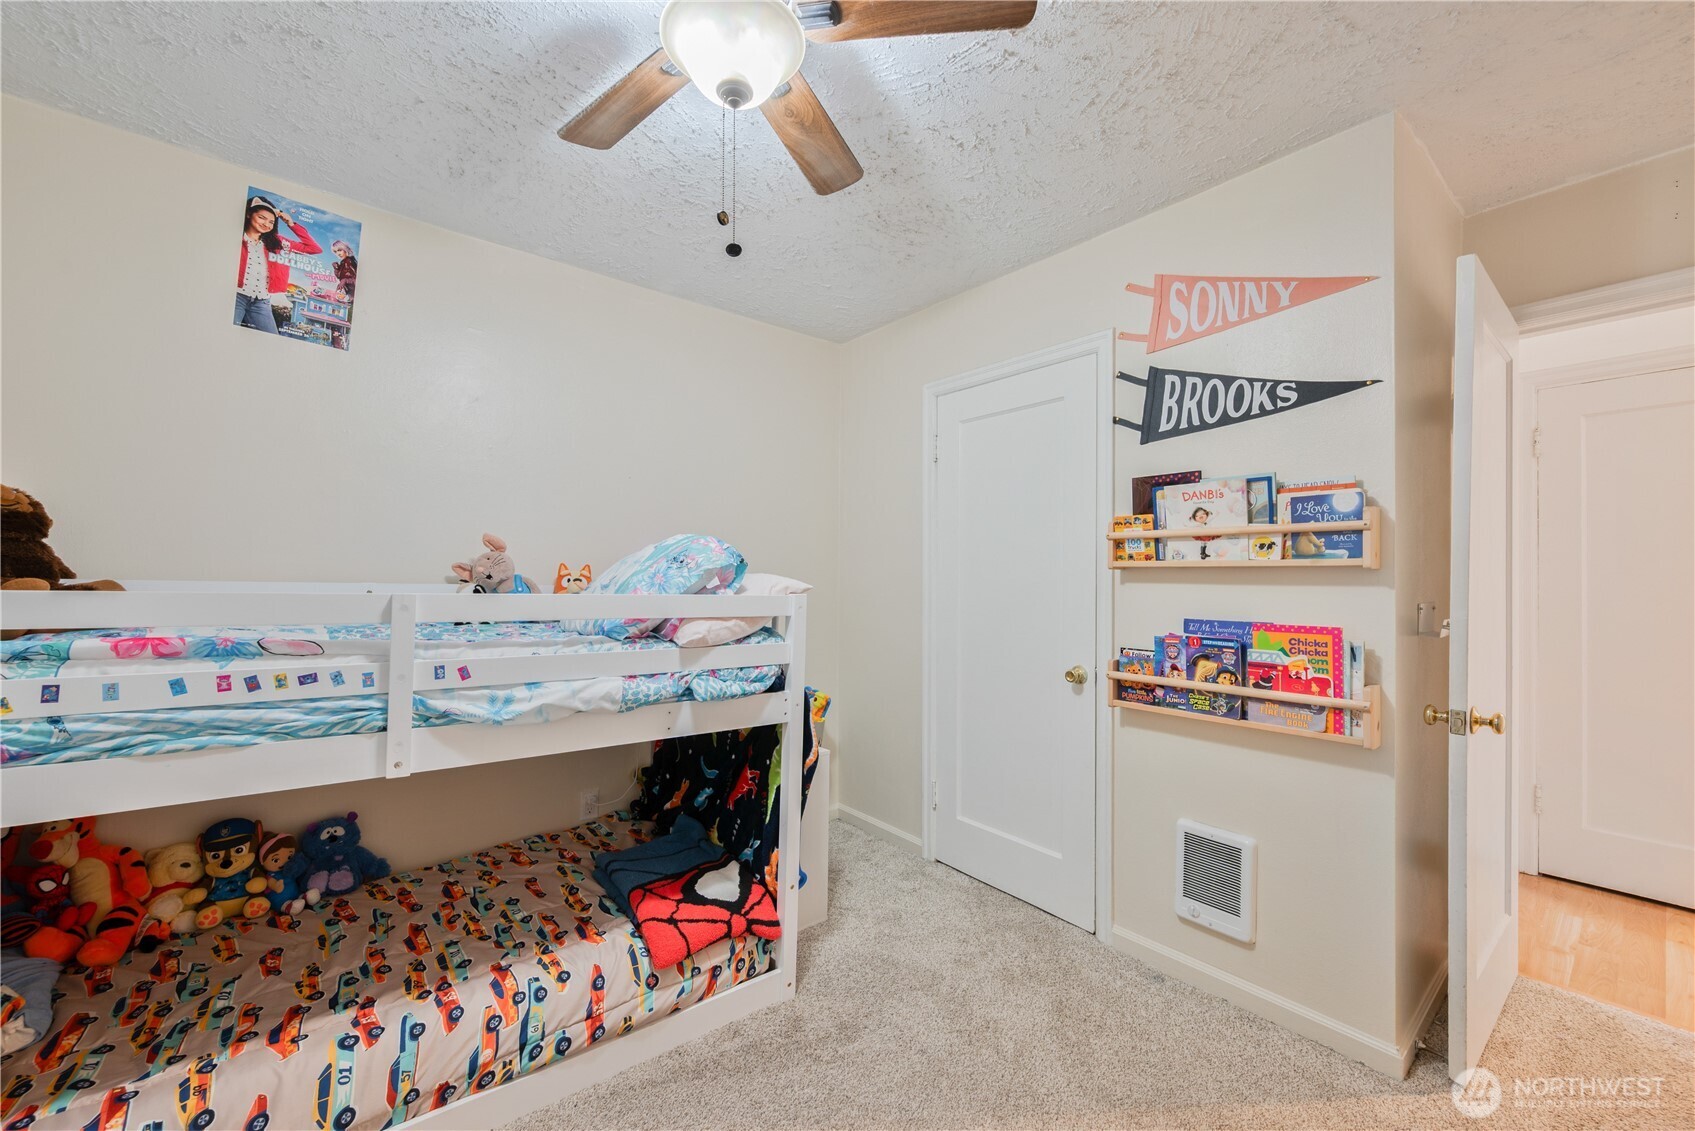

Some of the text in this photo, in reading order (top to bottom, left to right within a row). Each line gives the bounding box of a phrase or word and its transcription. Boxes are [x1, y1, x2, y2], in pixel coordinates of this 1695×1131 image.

[268, 252, 330, 275] DOLLHOUSE
[1166, 280, 1299, 342] SONNY
[1158, 374, 1298, 432] BROOKS
[1294, 502, 1302, 516] I
[1302, 501, 1331, 516] Love
[1188, 622, 1198, 631] Tell
[1200, 624, 1210, 632] Me
[1212, 625, 1243, 634] Something
[1289, 638, 1328, 648] Chicka
[1289, 647, 1328, 657] Chicka
[1166, 695, 1186, 704] JUNIO
[1265, 701, 1279, 710] The
[338, 1066, 352, 1086] 01
[400, 1070, 412, 1083] 57
